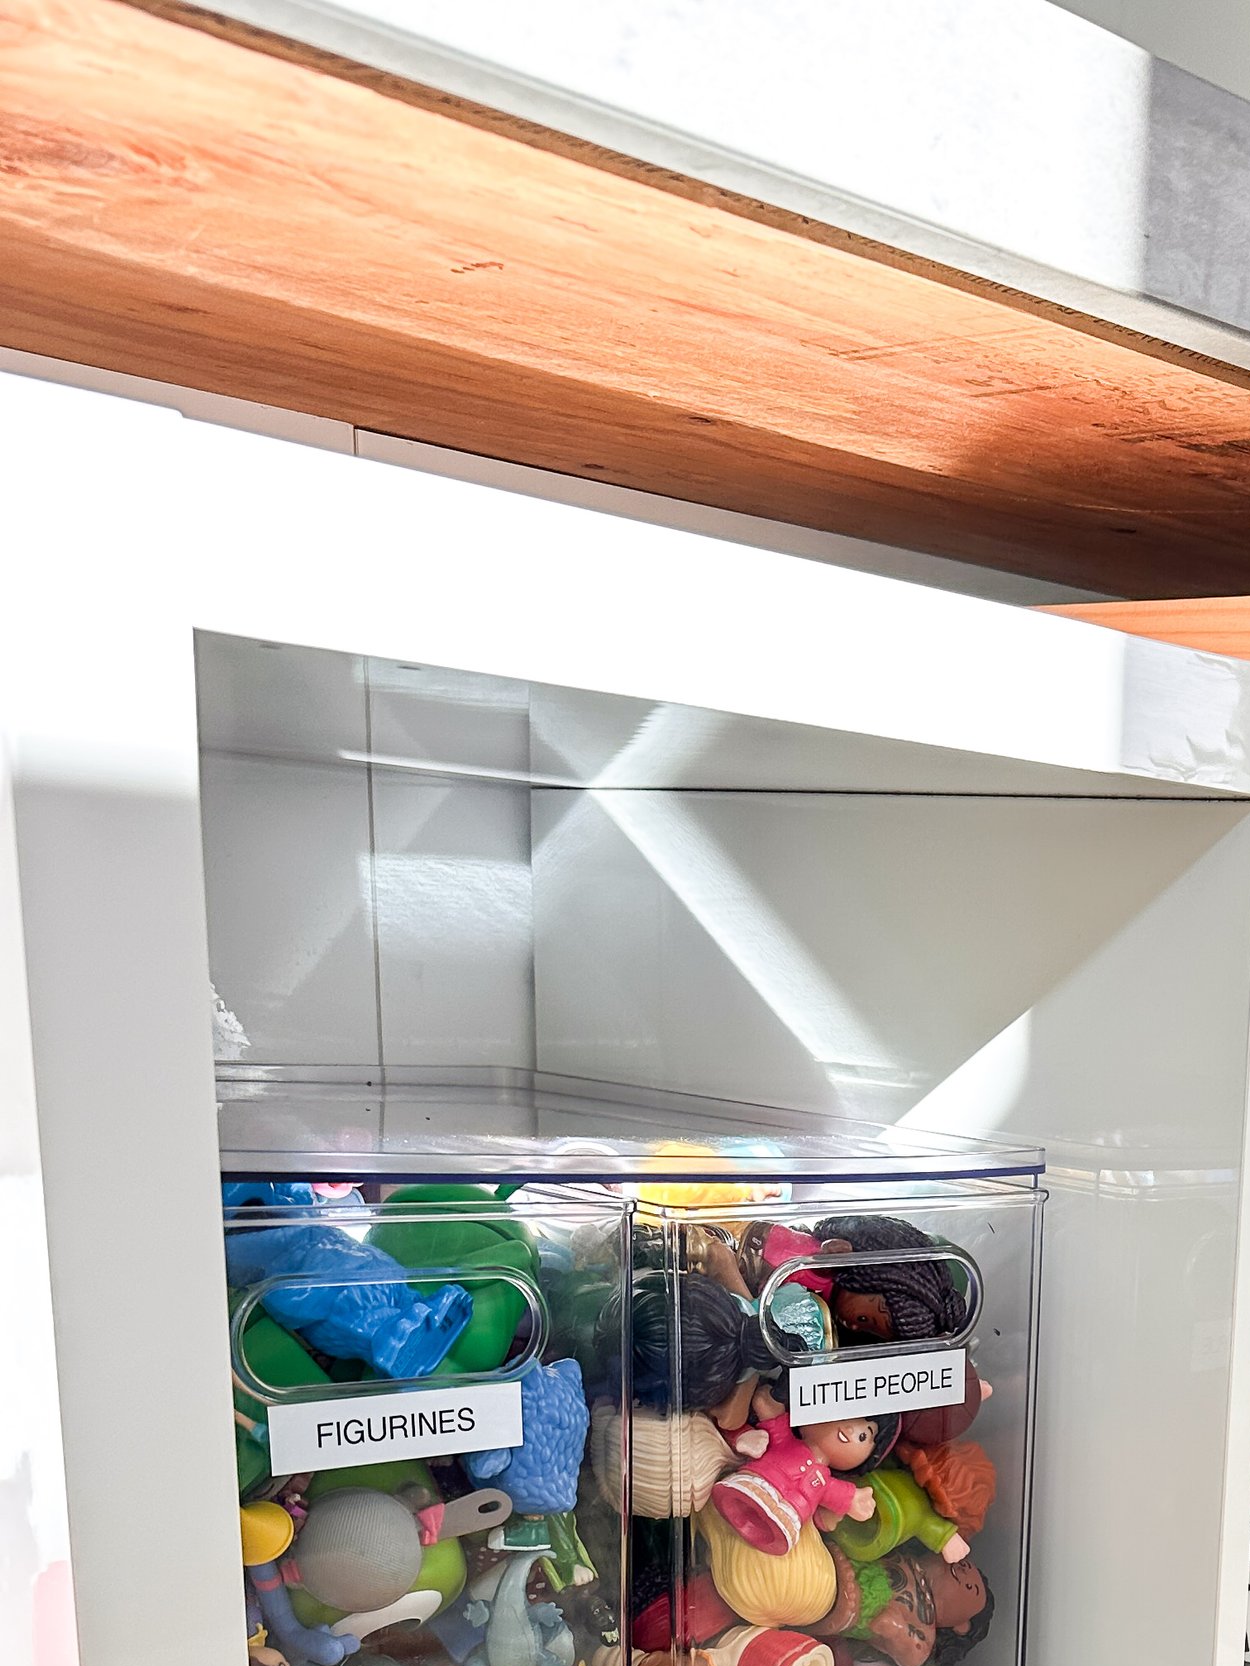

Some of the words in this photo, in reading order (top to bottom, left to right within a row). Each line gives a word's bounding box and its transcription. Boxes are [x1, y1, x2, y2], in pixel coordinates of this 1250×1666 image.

[800, 1378, 867, 1406] LITTLE
[874, 1367, 953, 1397] PEOPLE
[316, 1407, 475, 1449] FIGURINES
